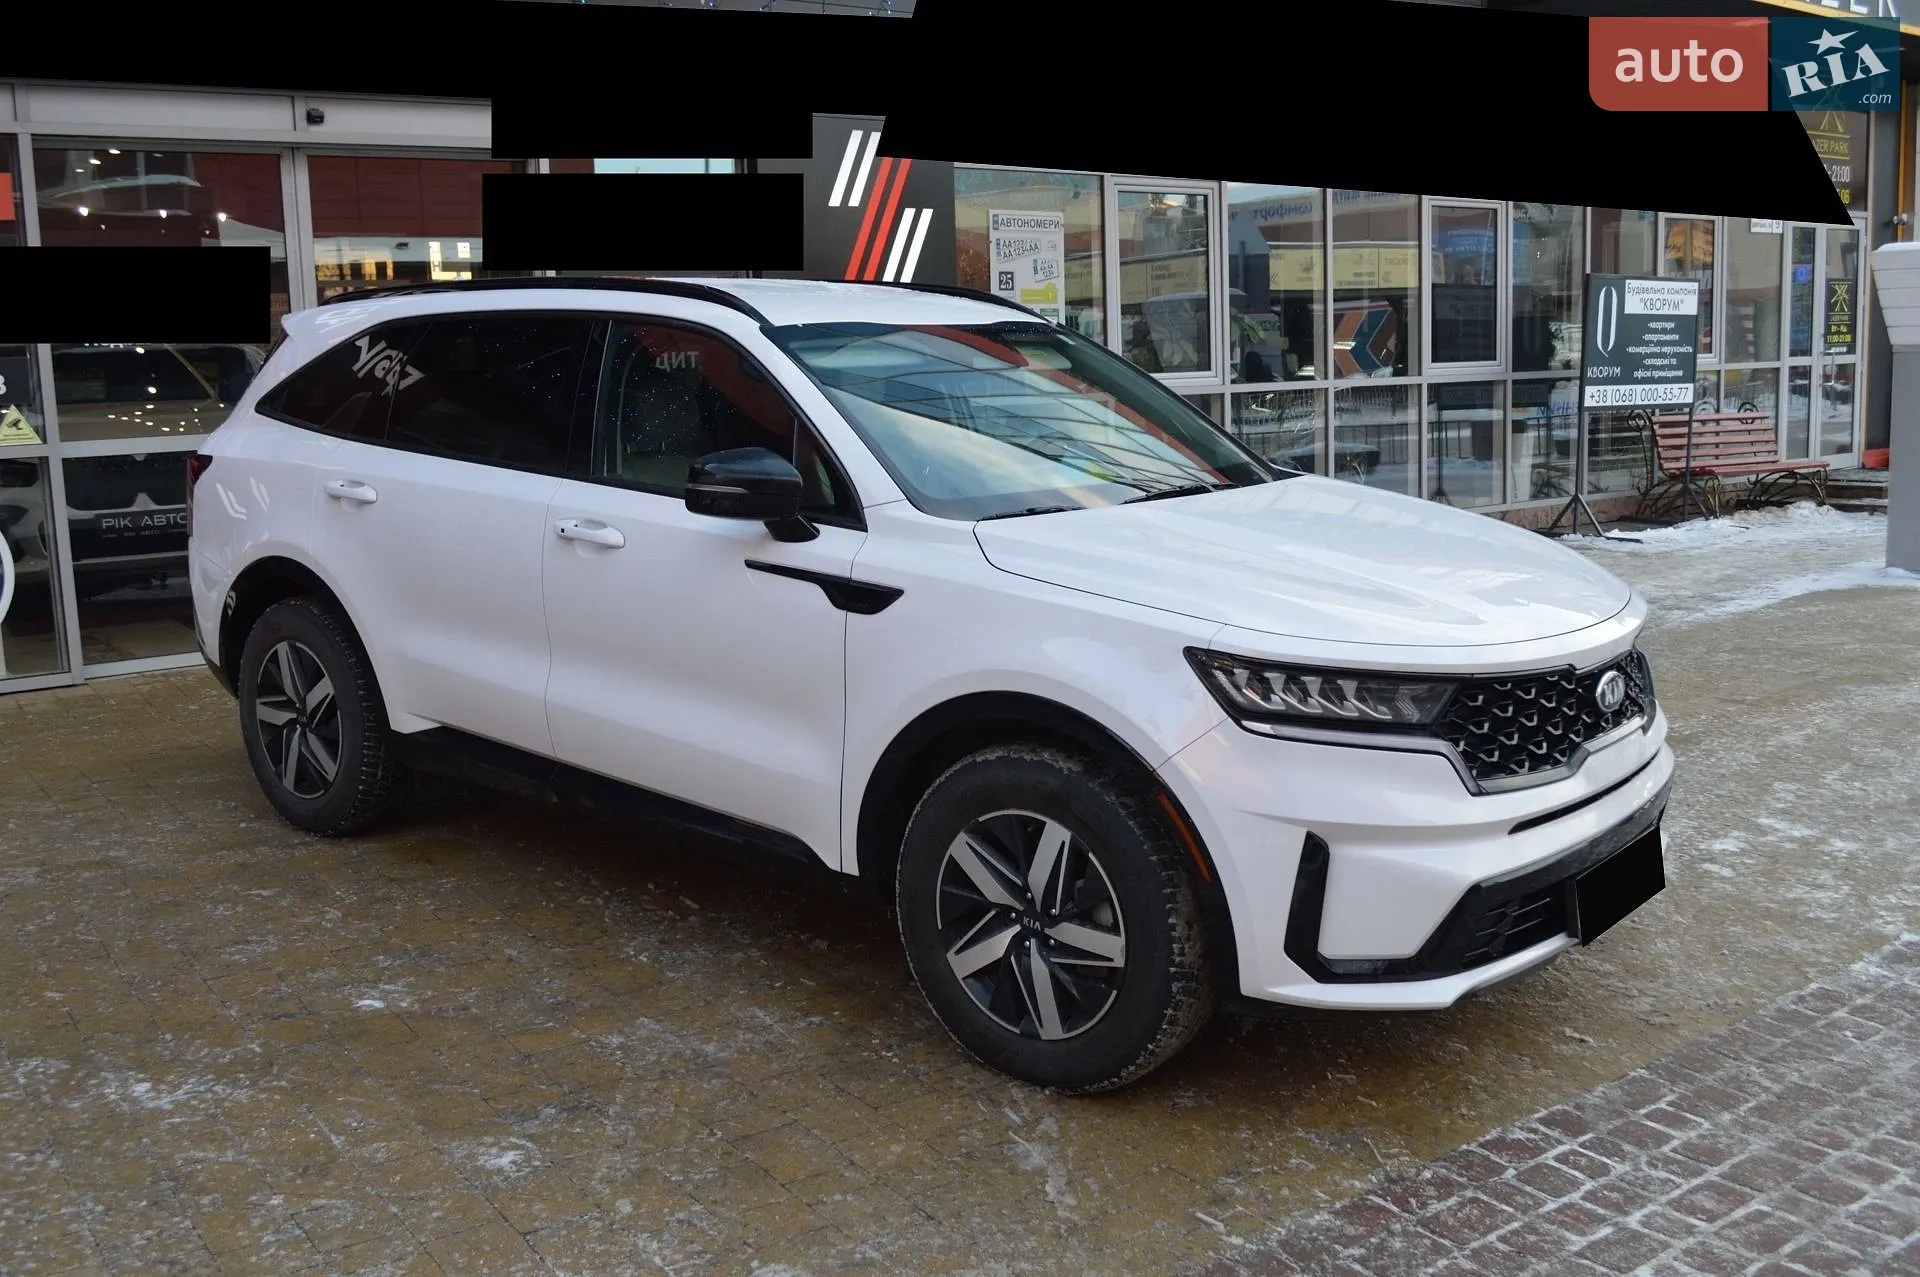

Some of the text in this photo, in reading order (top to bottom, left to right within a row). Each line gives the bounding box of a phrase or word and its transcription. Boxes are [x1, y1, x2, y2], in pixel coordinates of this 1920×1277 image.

[999, 217, 1060, 229] АВТОНОМЕРИ
[1000, 274, 1013, 289] 25
[1627, 282, 1697, 297] Будівельна компанія
[1640, 298, 1684, 311] "КВОРУМ"
[1587, 366, 1621, 378] КВОРУМ
[1589, 387, 1689, 405] +38 (068) 000-55-77
[102, 517, 133, 530] РІК
[1023, 916, 1041, 931] KIA
